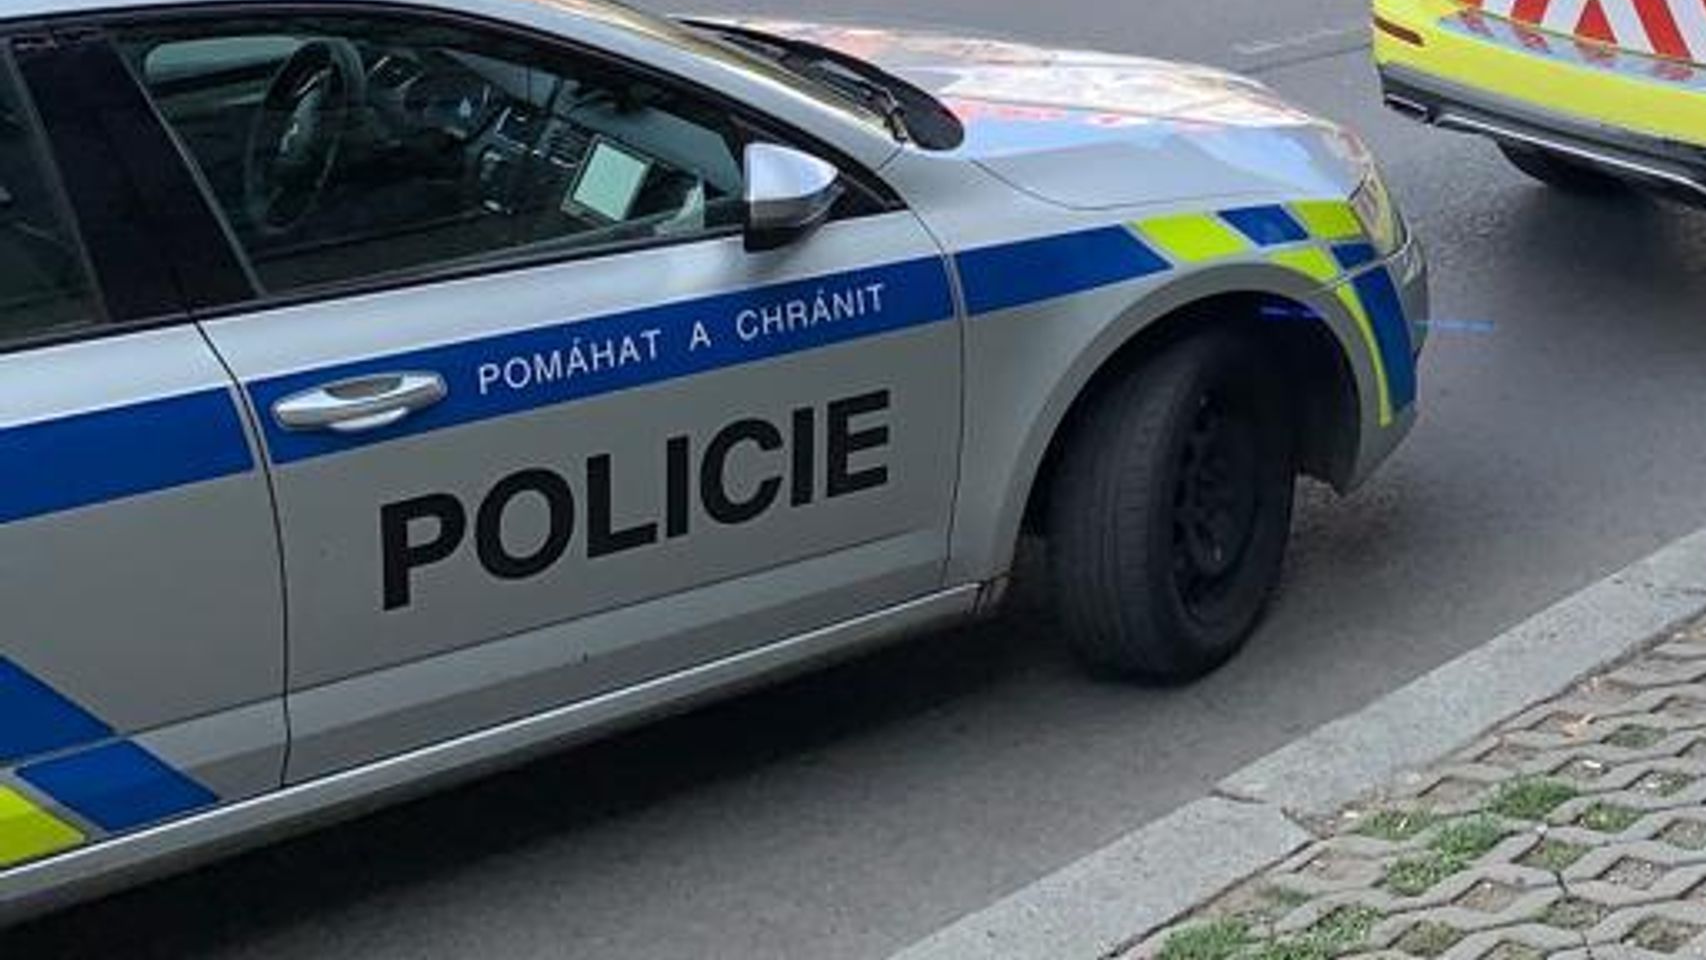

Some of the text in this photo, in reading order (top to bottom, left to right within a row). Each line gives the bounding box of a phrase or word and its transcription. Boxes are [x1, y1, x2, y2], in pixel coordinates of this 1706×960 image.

[478, 283, 886, 395] POMÁHAT A CHRÁNIT
[379, 388, 893, 612] POLICIE
